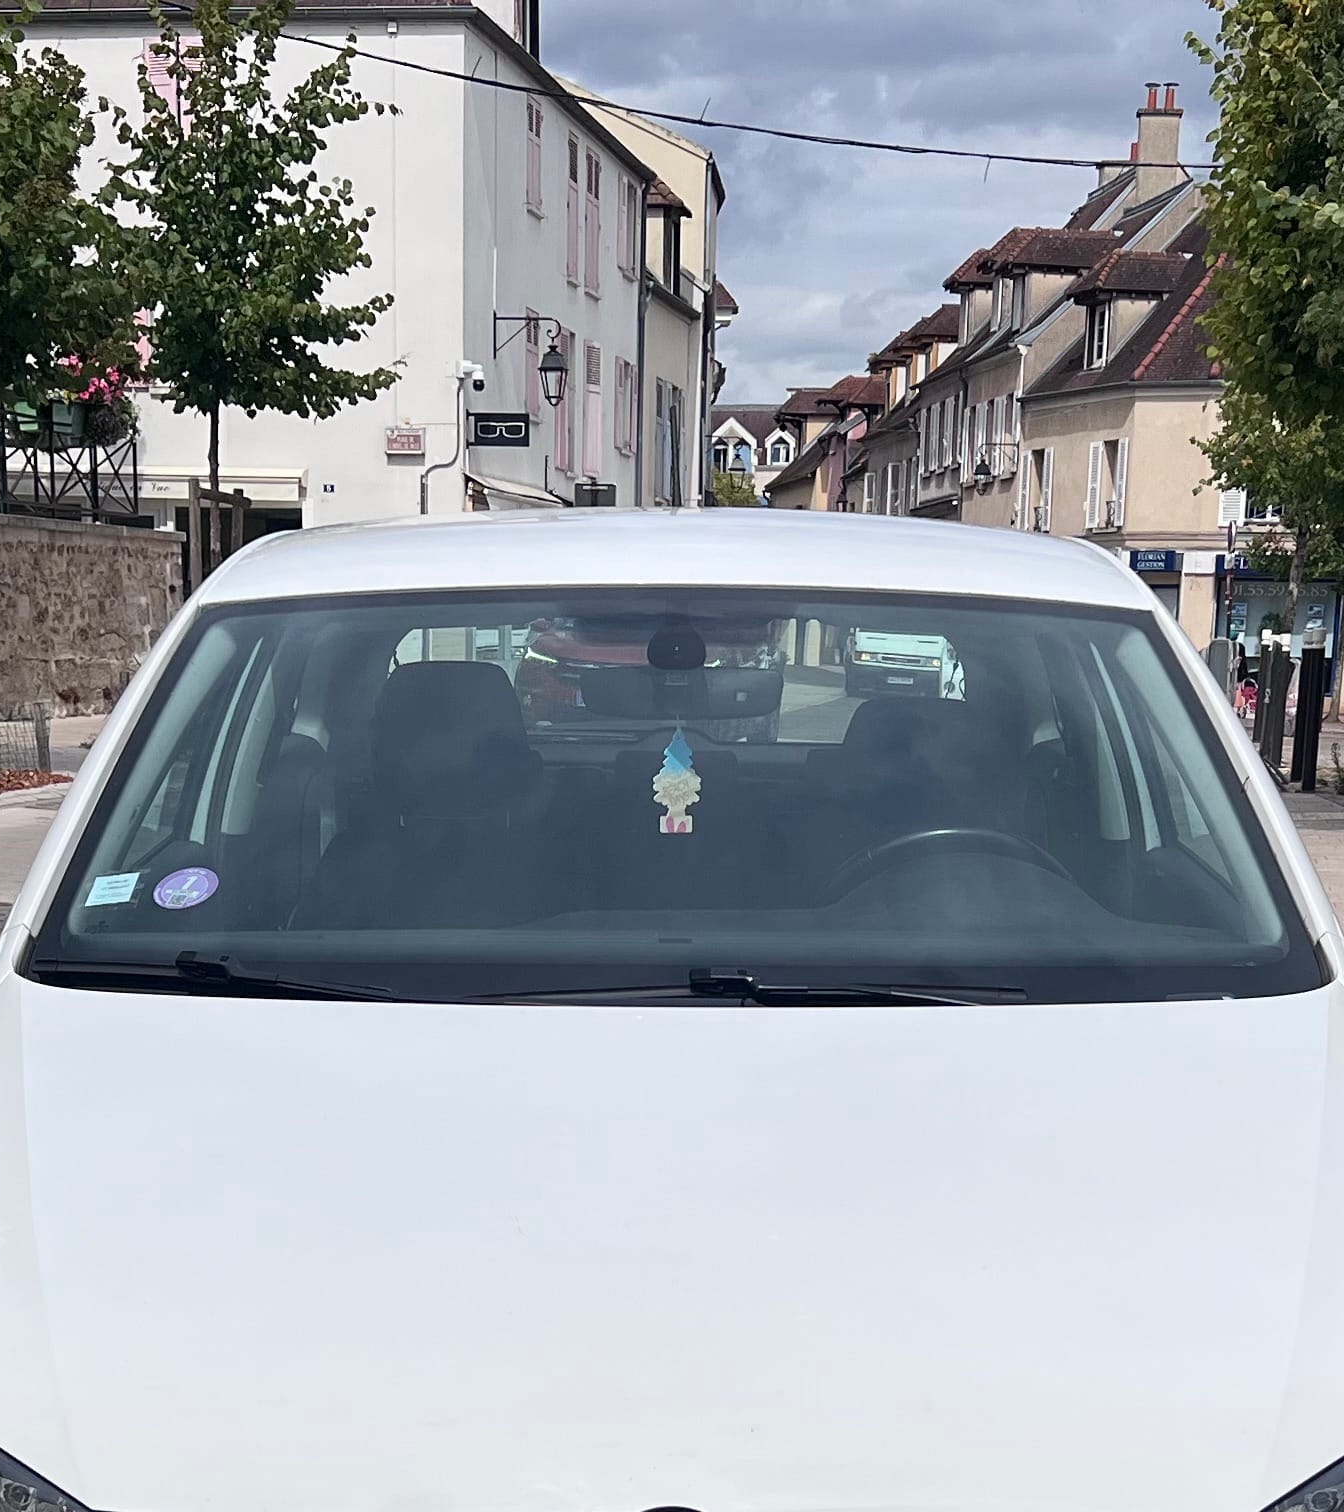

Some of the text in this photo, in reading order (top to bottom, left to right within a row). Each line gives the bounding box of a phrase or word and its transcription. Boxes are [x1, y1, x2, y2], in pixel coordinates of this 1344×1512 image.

[1137, 551, 1166, 561] FLORIAN
[1136, 561, 1165, 569] GESTION
[181, 875, 199, 890] 1
